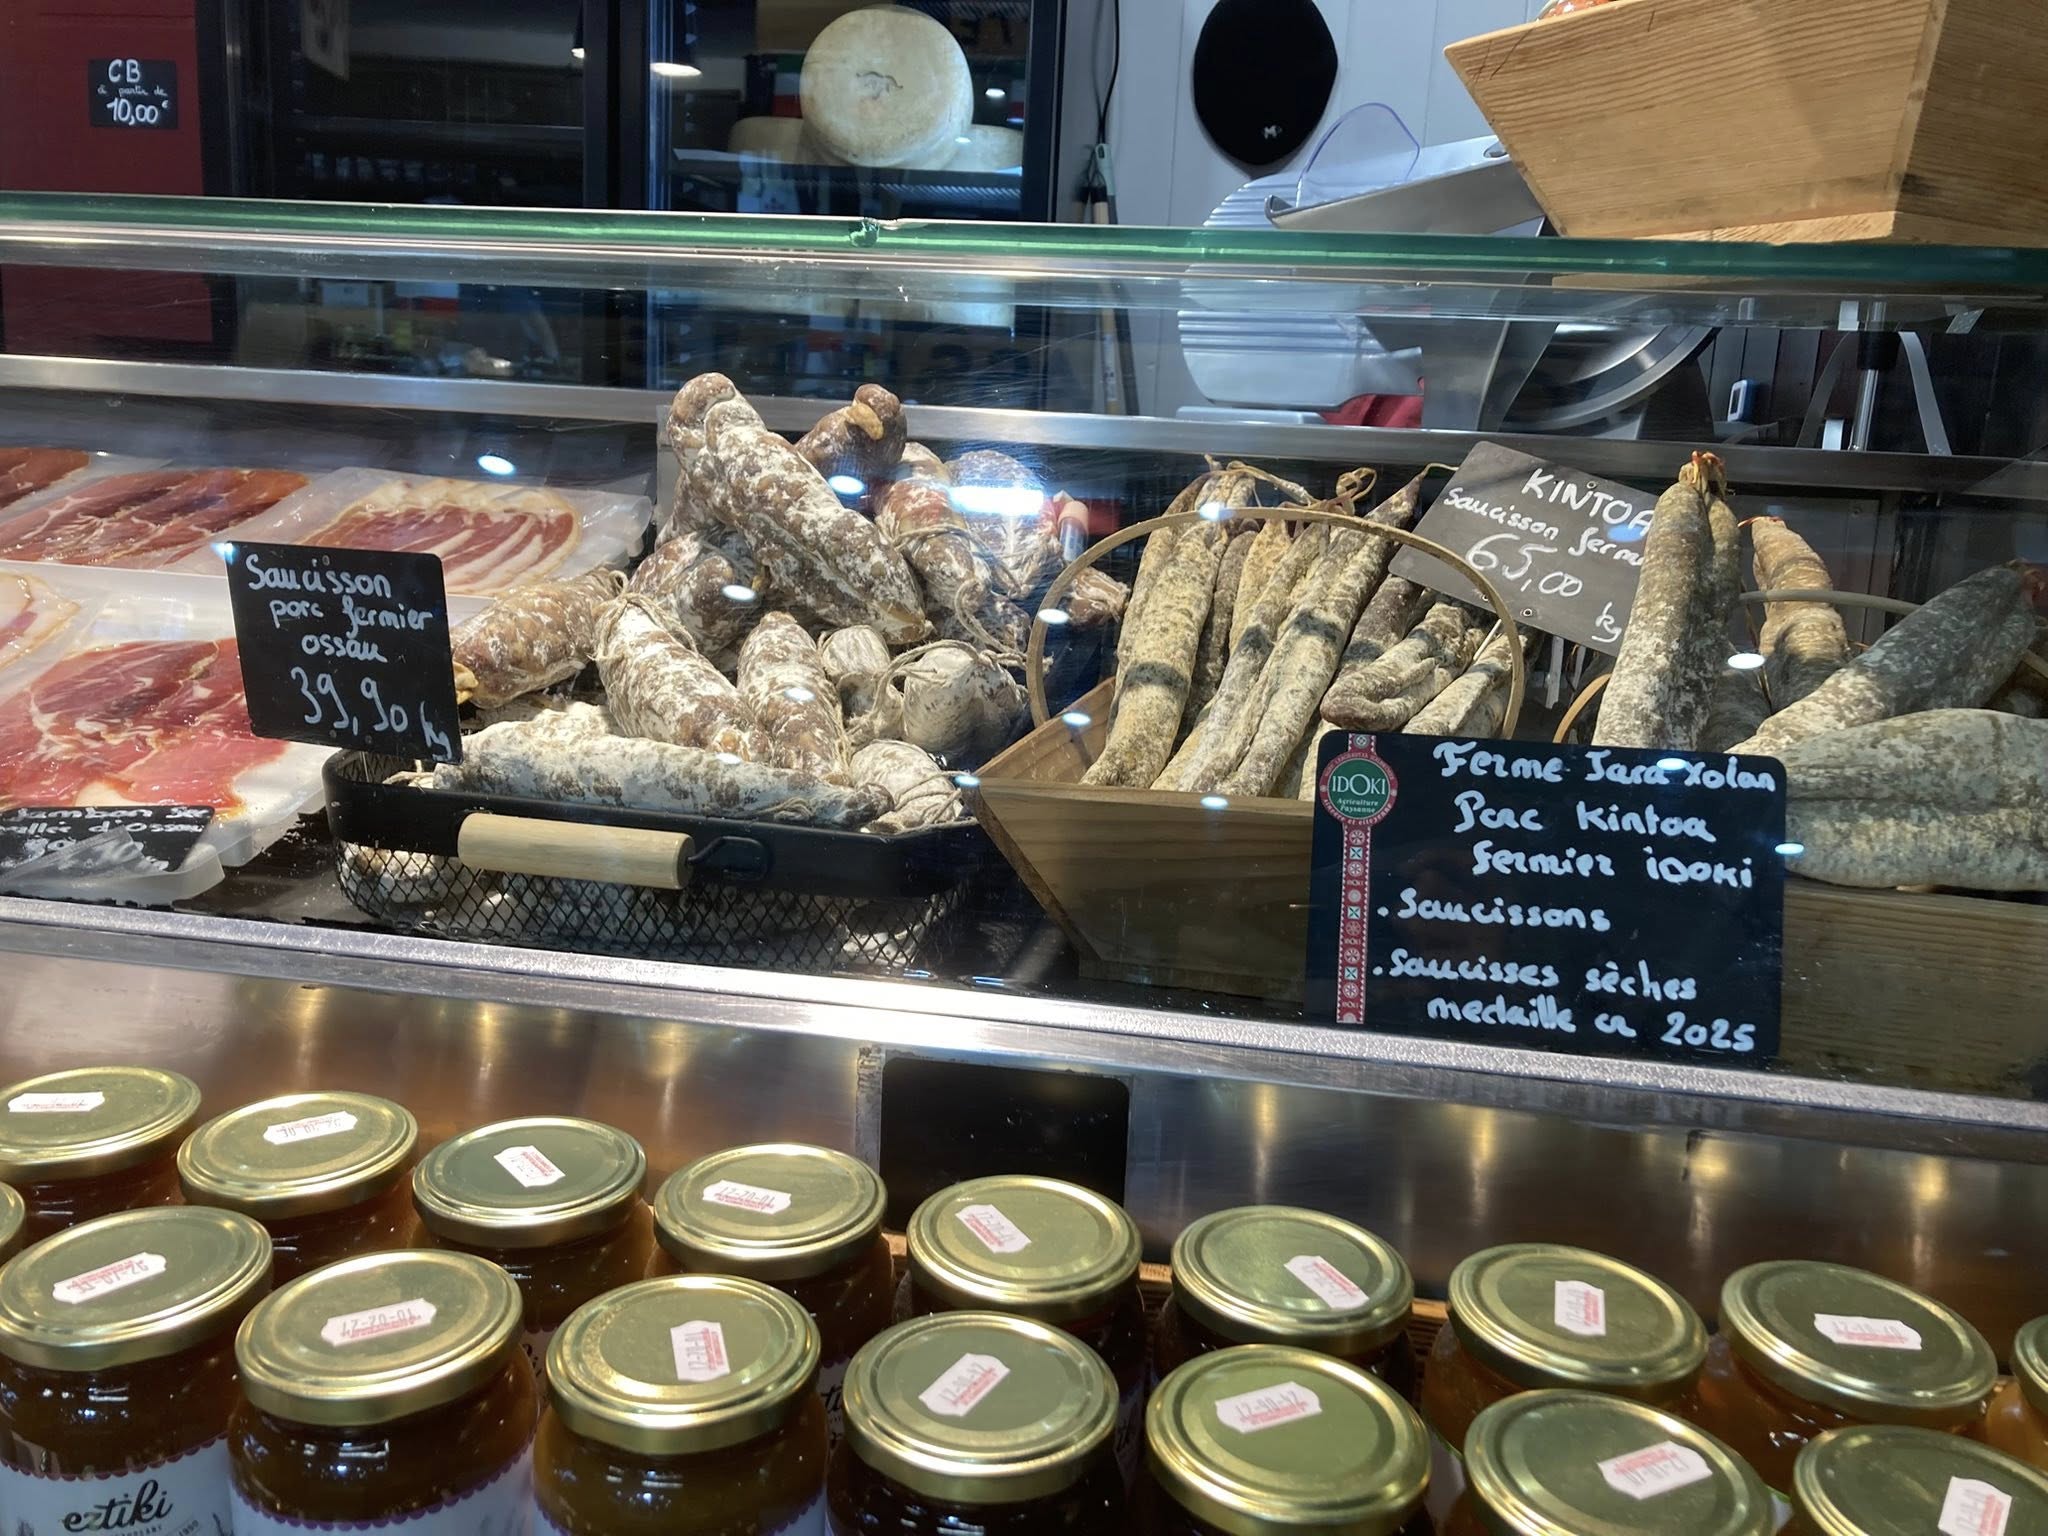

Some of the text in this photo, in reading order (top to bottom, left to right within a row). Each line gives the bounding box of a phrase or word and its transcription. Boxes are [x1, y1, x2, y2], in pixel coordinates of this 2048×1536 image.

[108, 58, 140, 83] CB
[153, 84, 168, 97] de
[1521, 468, 1655, 537] KINTOA
[245, 553, 392, 599] Saucisson
[1465, 532, 1584, 597] 65,00
[268, 594, 434, 639] porc fermier
[1591, 601, 1623, 644] kg
[290, 665, 409, 737] 39,90
[1433, 741, 1563, 784] Ferme
[1331, 773, 1386, 796] IDOKI
[1336, 797, 1379, 807] Agriculture
[1397, 887, 1612, 932] Saucissons
[1388, 947, 1560, 988] Saucisses
[1660, 1011, 1757, 1052] 2025
[61, 1479, 173, 1533] eztiki
